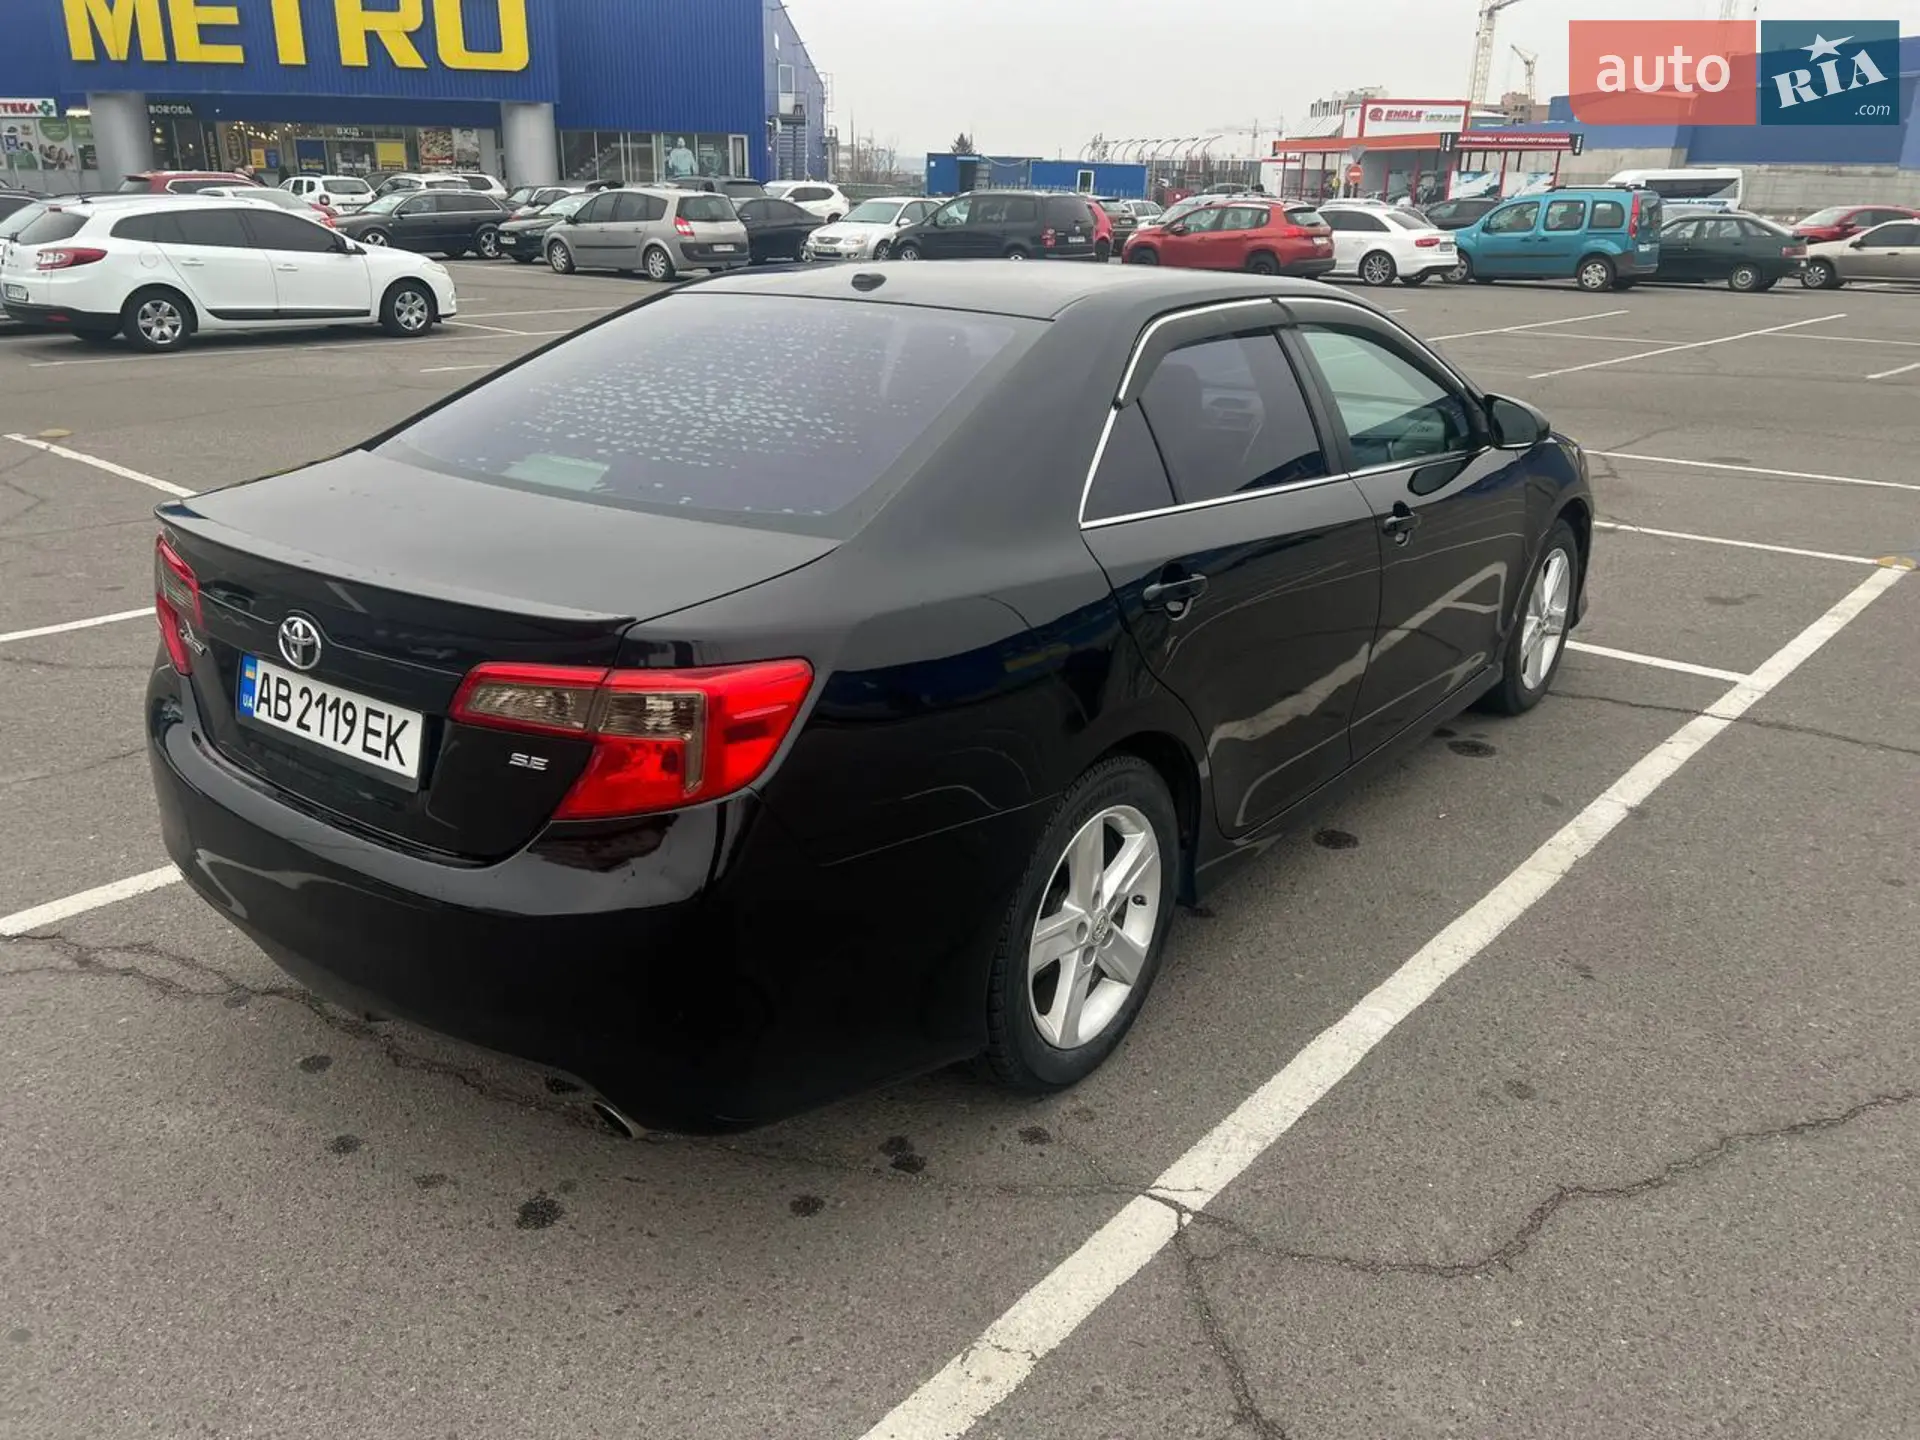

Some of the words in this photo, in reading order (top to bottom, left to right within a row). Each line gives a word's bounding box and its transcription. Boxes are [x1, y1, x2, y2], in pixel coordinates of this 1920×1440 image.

[242, 692, 254, 709] UA
[255, 671, 292, 723] AB
[296, 686, 357, 746] 2119
[361, 706, 409, 767] EK
[508, 752, 549, 771] SE
